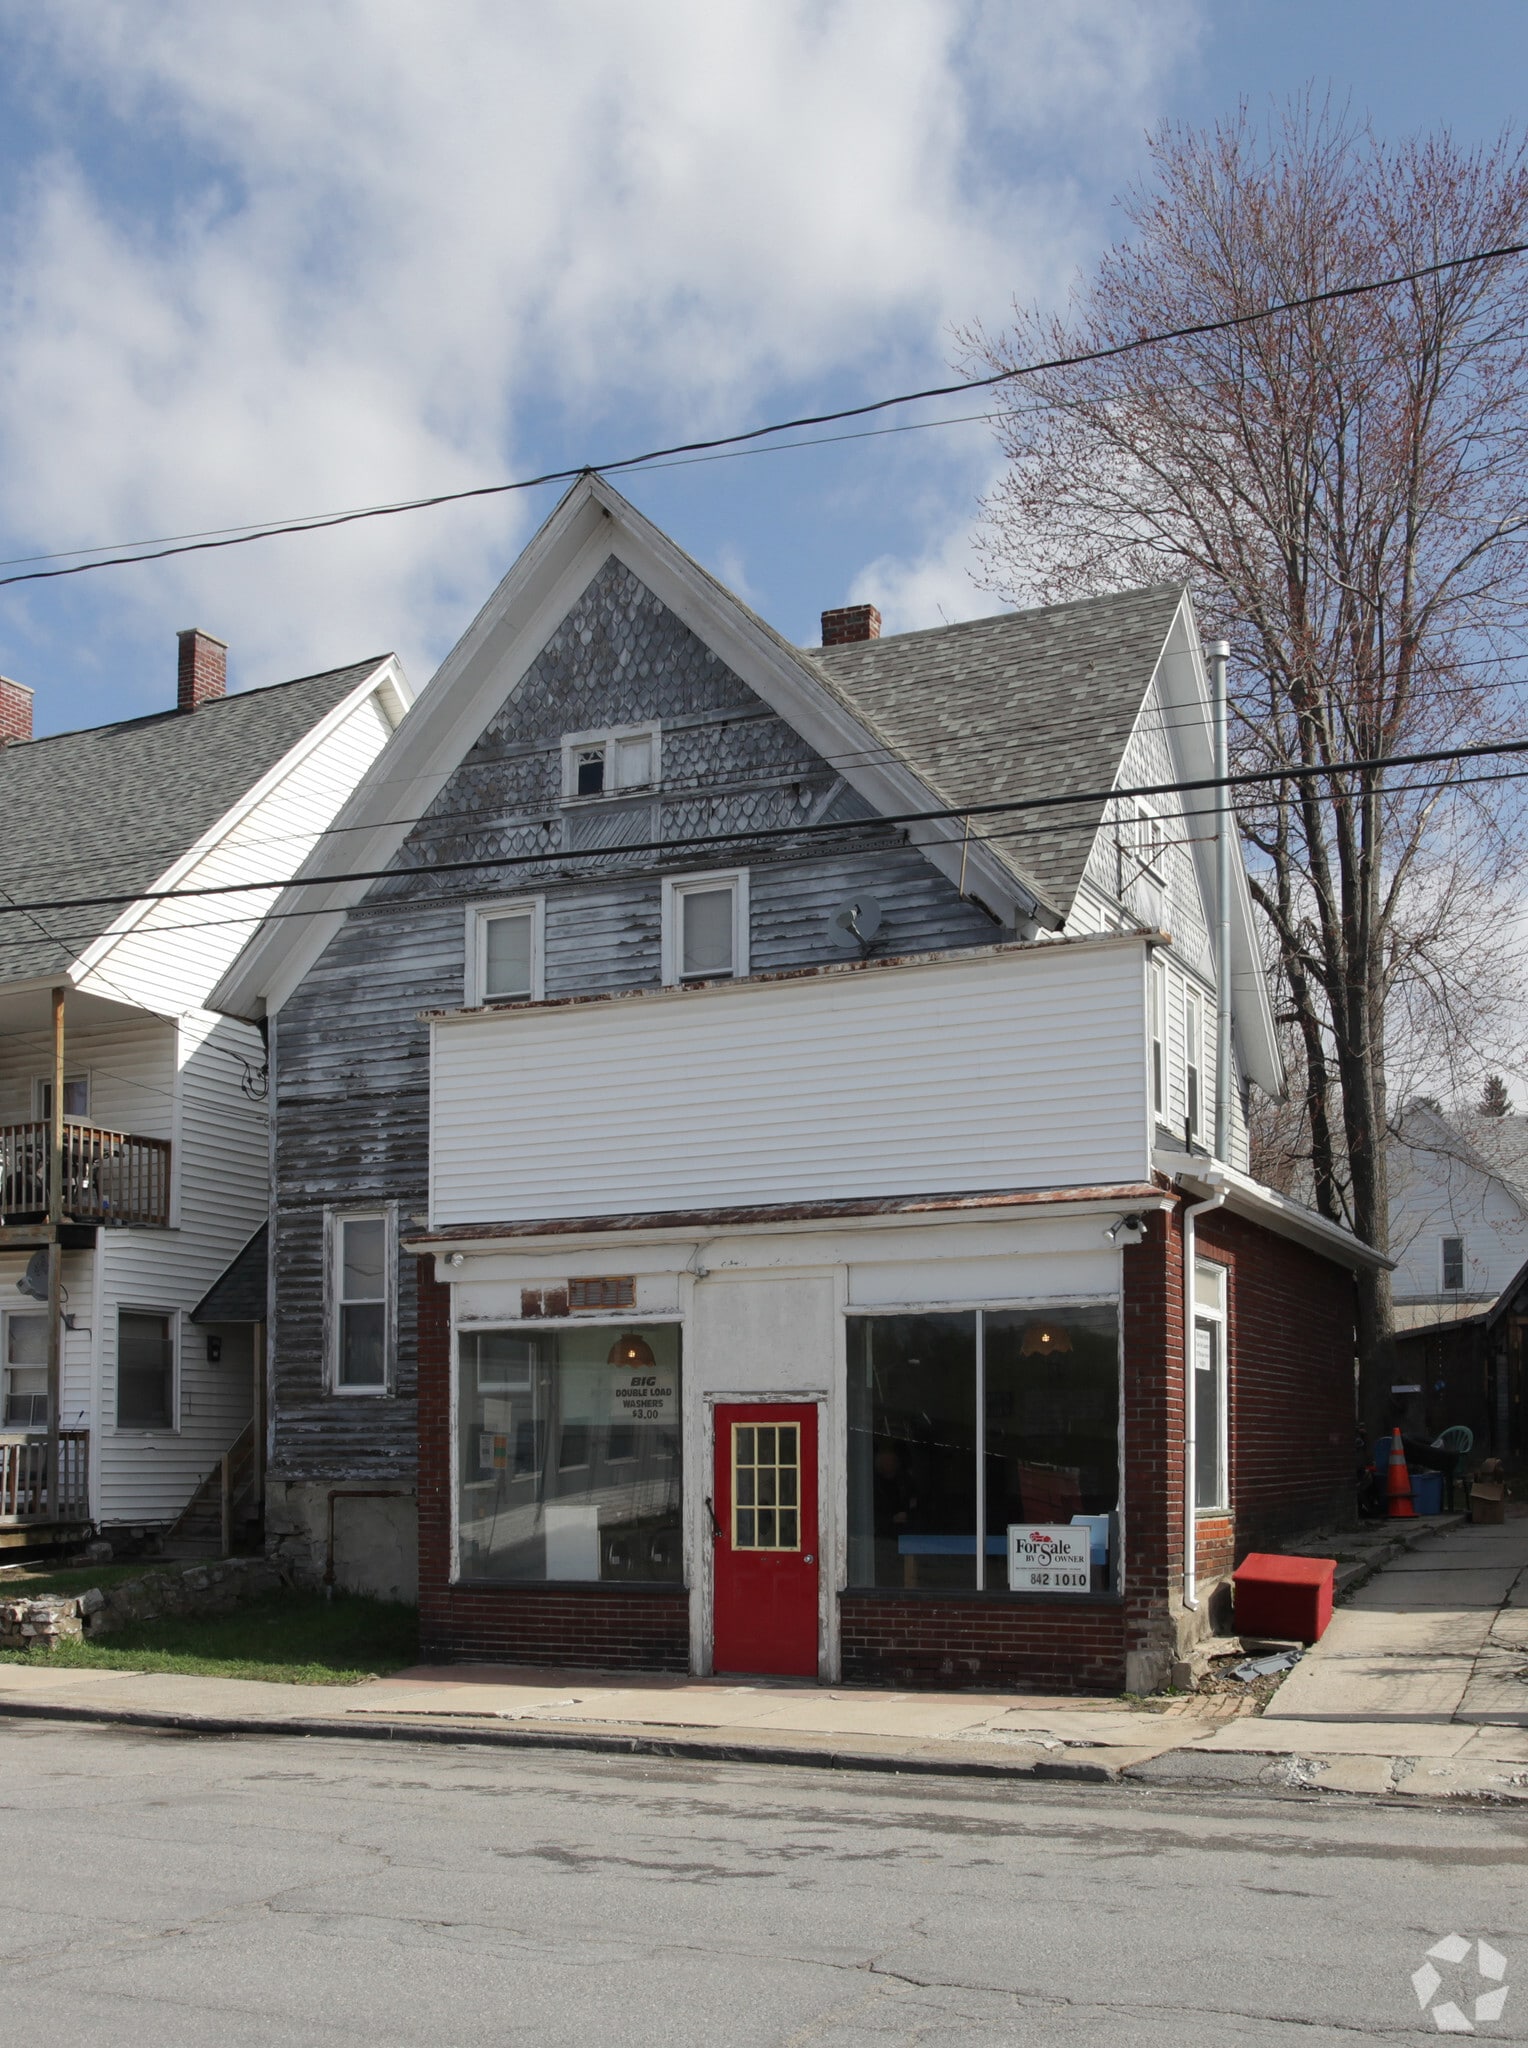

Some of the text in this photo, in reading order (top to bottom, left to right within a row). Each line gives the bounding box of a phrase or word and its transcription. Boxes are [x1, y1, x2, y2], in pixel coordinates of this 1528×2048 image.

[631, 1376, 656, 1386] BIG
[616, 1388, 672, 1397] DOUBLE LOAD
[623, 1400, 663, 1408] WASHERS
[632, 1409, 658, 1419] $3.00
[1054, 1555, 1084, 1563] OWNER
[1030, 1573, 1086, 1586] 842 1010
